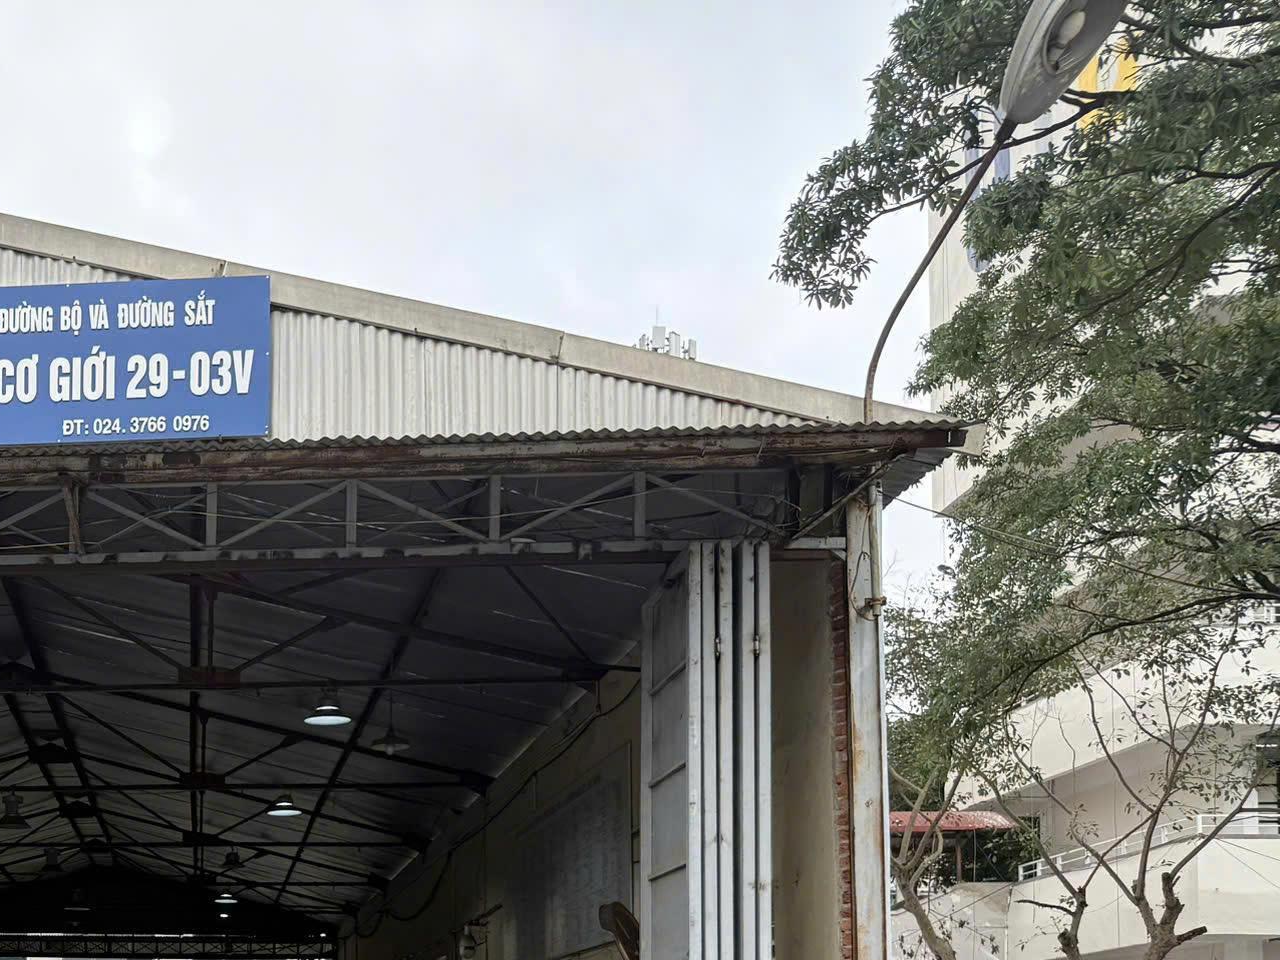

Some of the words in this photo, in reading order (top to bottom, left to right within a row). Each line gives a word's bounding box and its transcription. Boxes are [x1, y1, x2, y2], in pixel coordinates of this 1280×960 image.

[60, 300, 82, 336] BỘ
[89, 299, 109, 329] VÀ
[117, 296, 174, 329] ĐƯỜNG
[184, 290, 215, 326] SẮT
[49, 345, 115, 402] GIỚI
[126, 349, 255, 399] 29-03V
[62, 419, 89, 436] ĐT:
[130, 416, 166, 433] 3766
[173, 415, 210, 432] 0976
